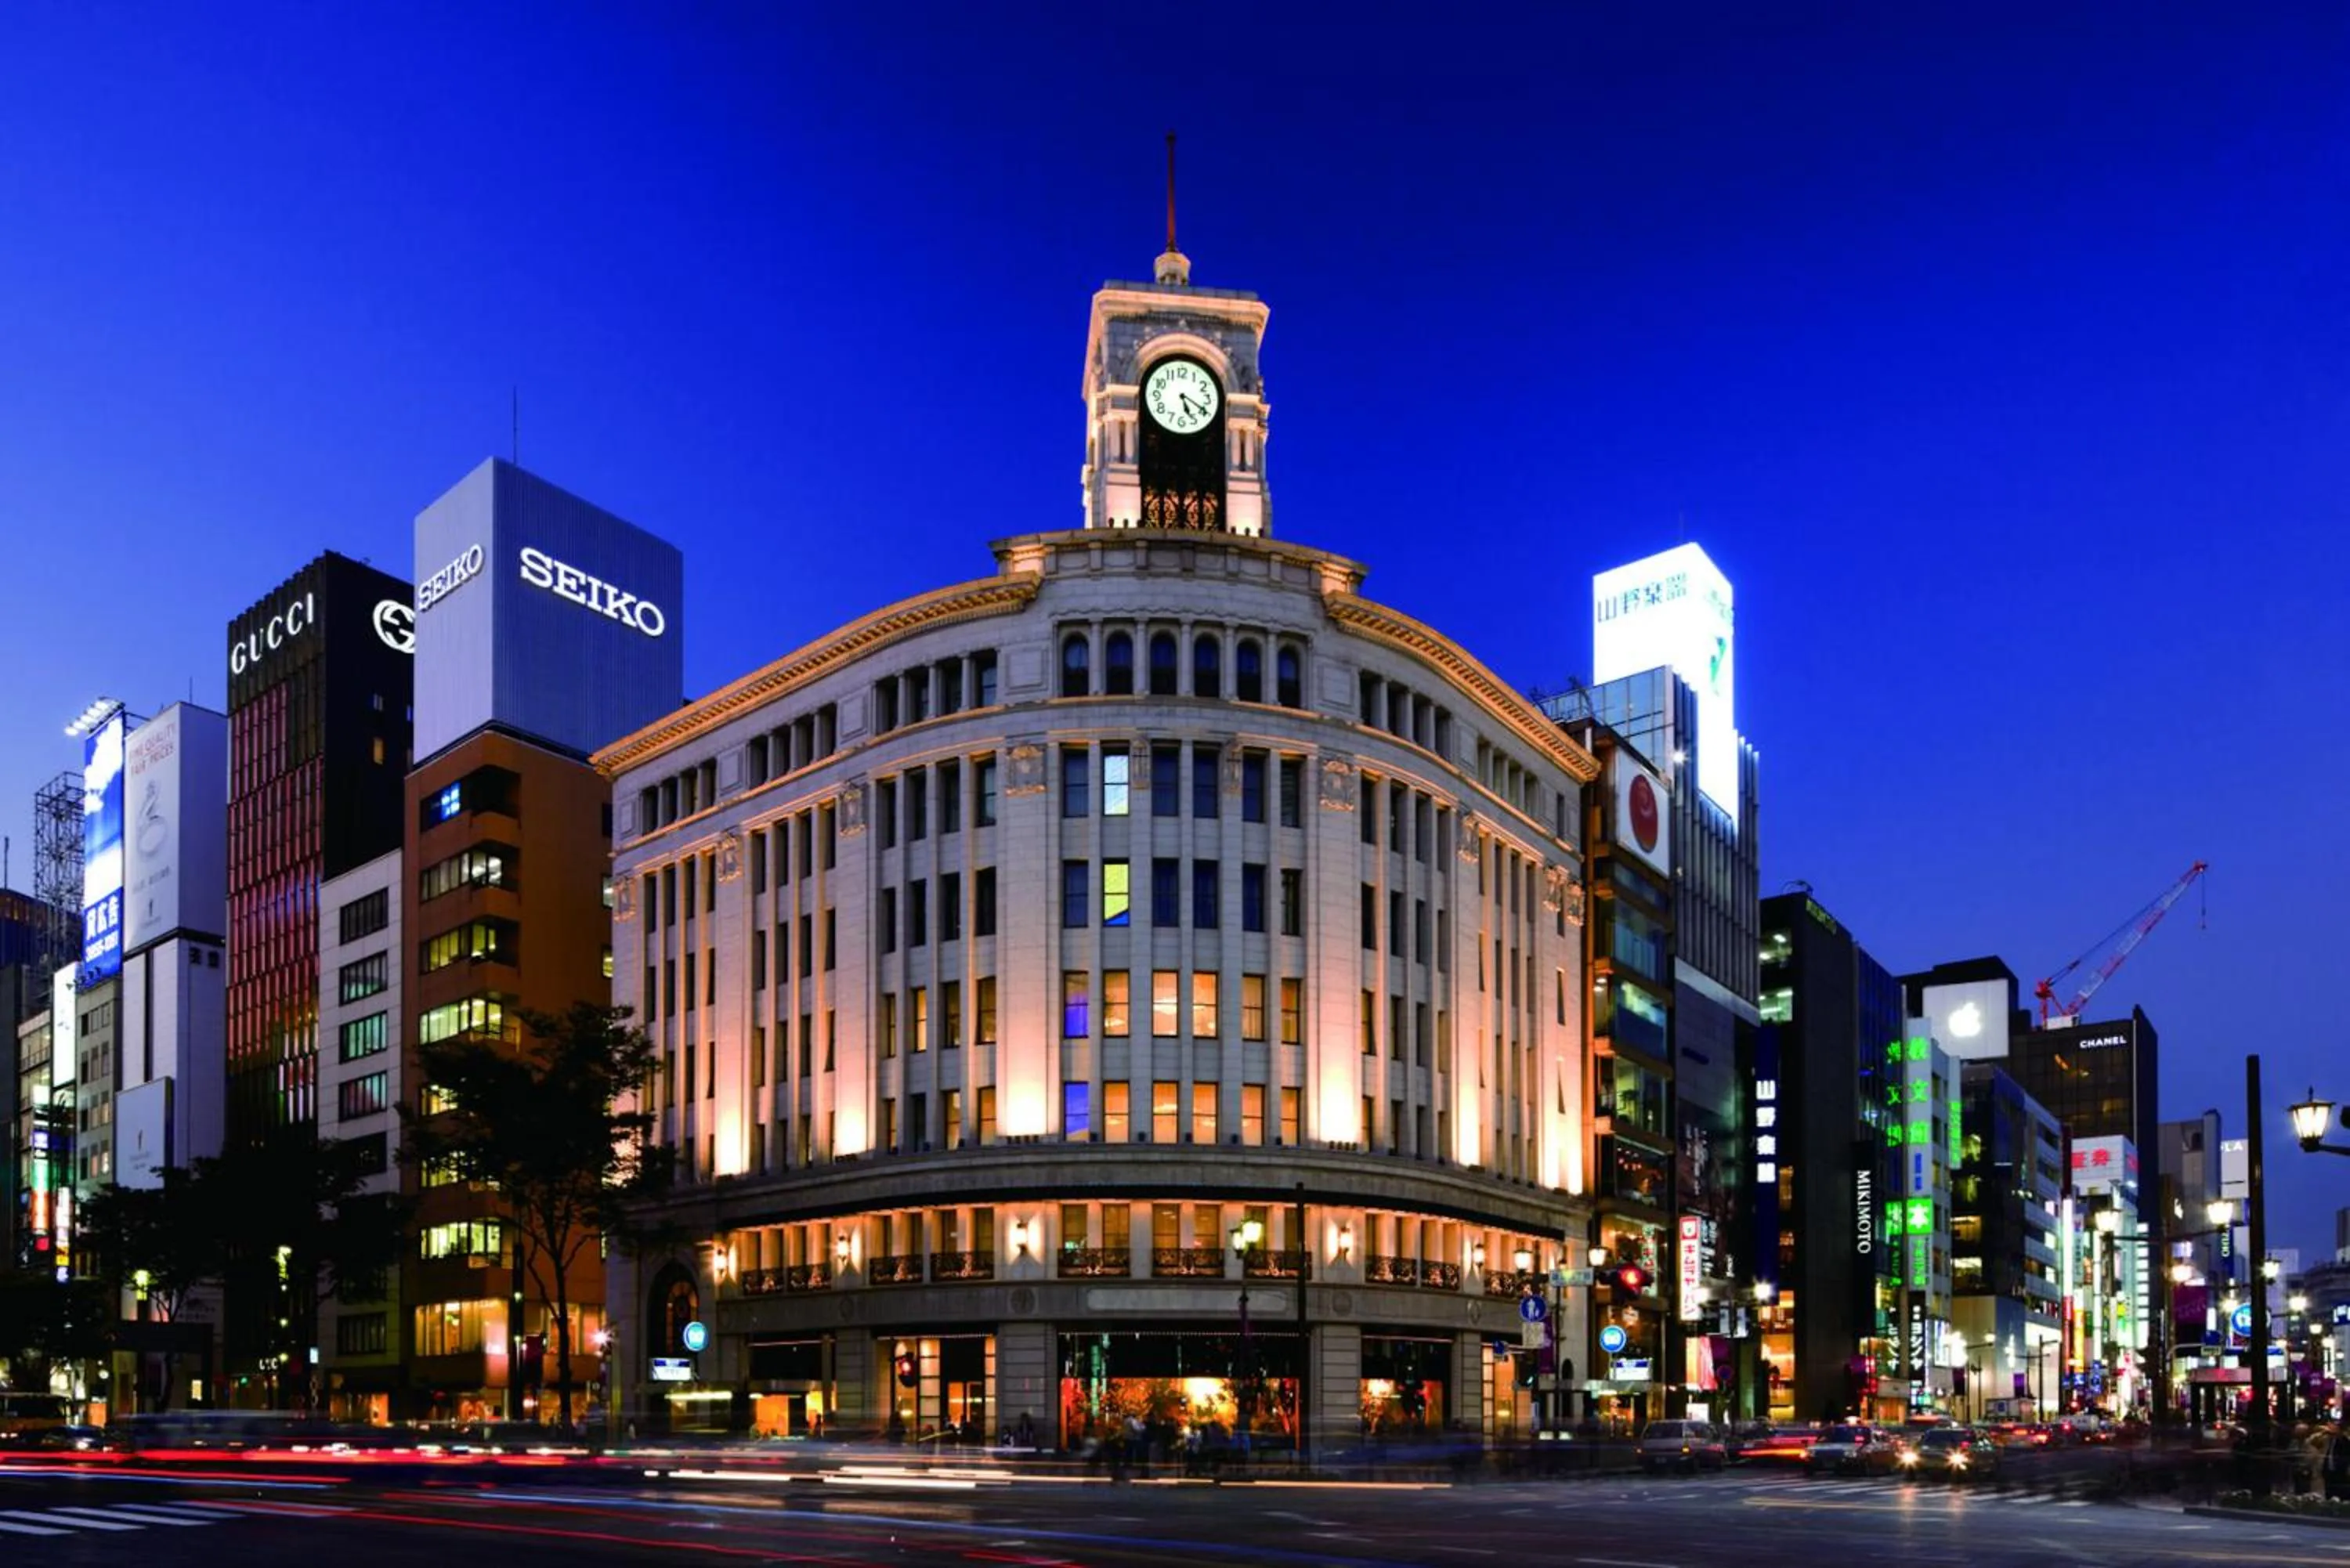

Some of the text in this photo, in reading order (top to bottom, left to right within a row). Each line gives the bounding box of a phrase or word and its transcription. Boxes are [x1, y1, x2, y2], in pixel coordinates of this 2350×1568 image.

[1166, 369, 1174, 382] 11
[1177, 367, 1188, 379] 12
[1192, 371, 1196, 383] 1
[1155, 378, 1166, 390] 10
[1199, 380, 1208, 392] 2
[1152, 390, 1161, 402] 9
[1203, 393, 1212, 405] 3
[1156, 402, 1166, 414] 8
[1167, 411, 1176, 423] 7
[1177, 416, 1186, 428] 6
[1188, 413, 1198, 425] 5
[418, 544, 483, 611] SEIKO
[520, 547, 665, 637] SEIKO
[231, 592, 313, 674] GUCCI
[2080, 1035, 2127, 1049] CHANEL
[1857, 1170, 1871, 1254] MIKIMOTO
